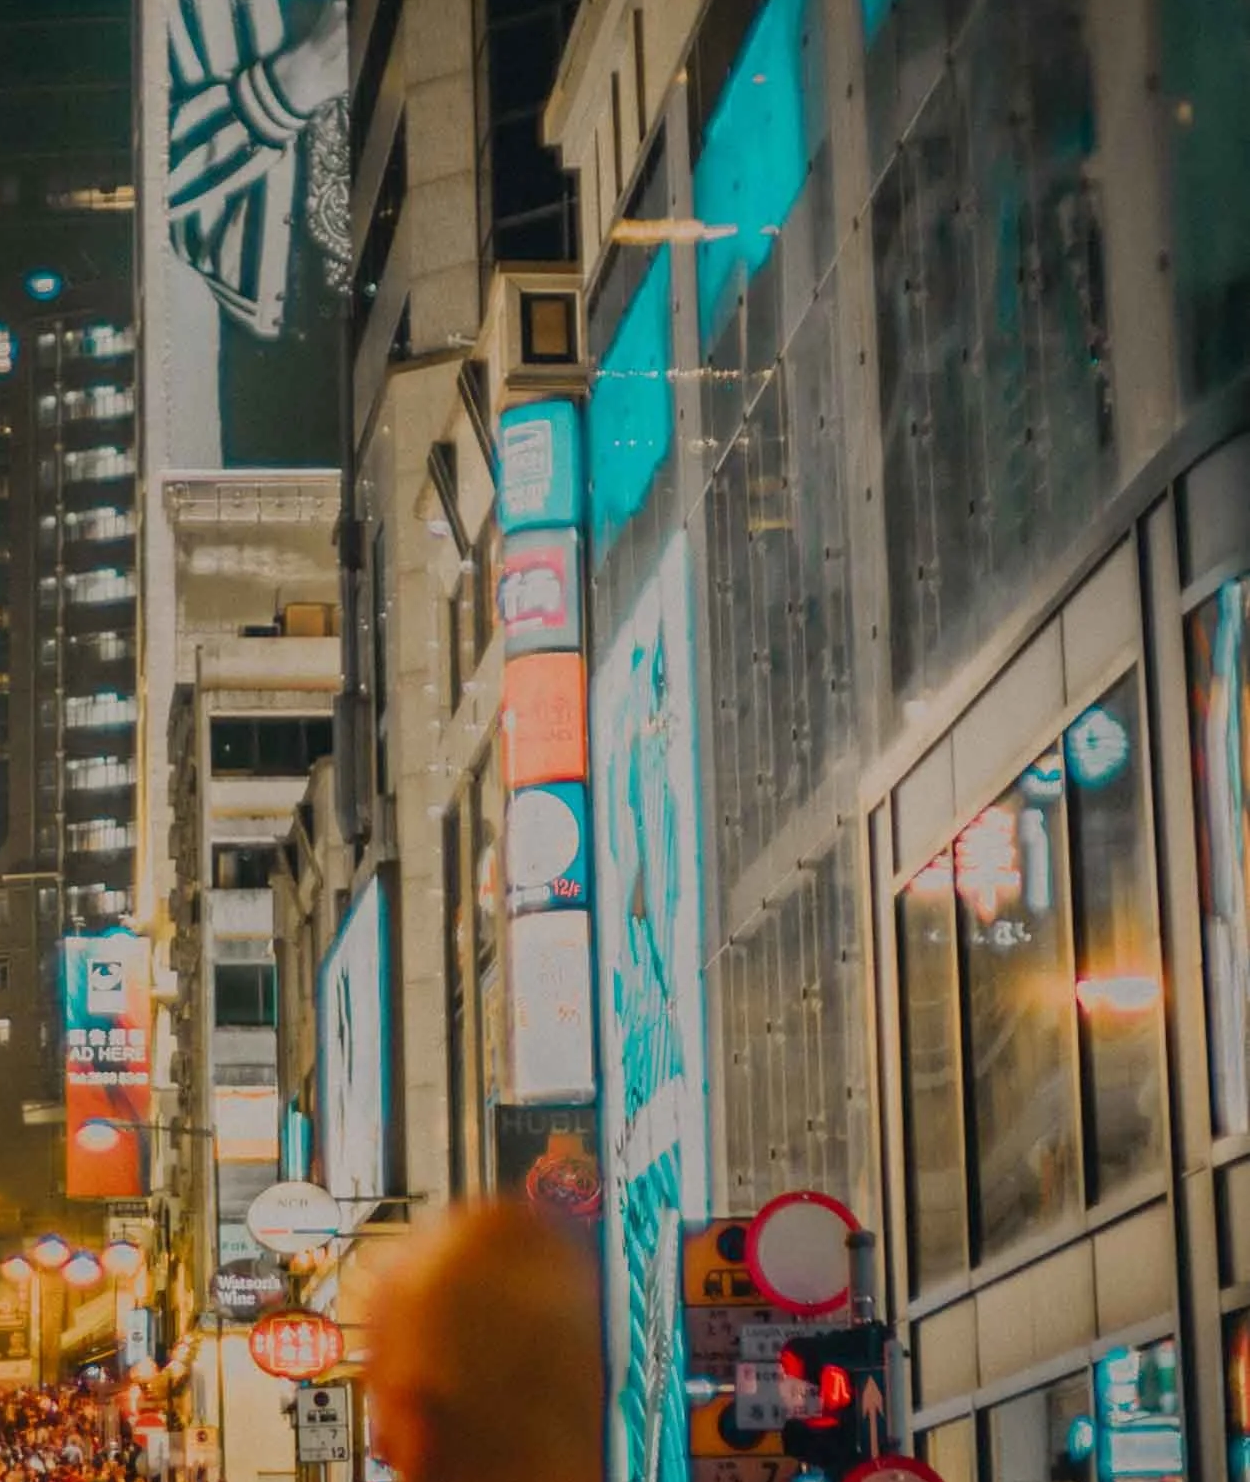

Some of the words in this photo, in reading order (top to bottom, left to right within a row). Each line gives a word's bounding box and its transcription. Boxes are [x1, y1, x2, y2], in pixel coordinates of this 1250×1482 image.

[69, 1046, 95, 1062] AD
[98, 1046, 147, 1062] HERE
[216, 1290, 256, 1306] Wine
[332, 1447, 346, 1459] 12
